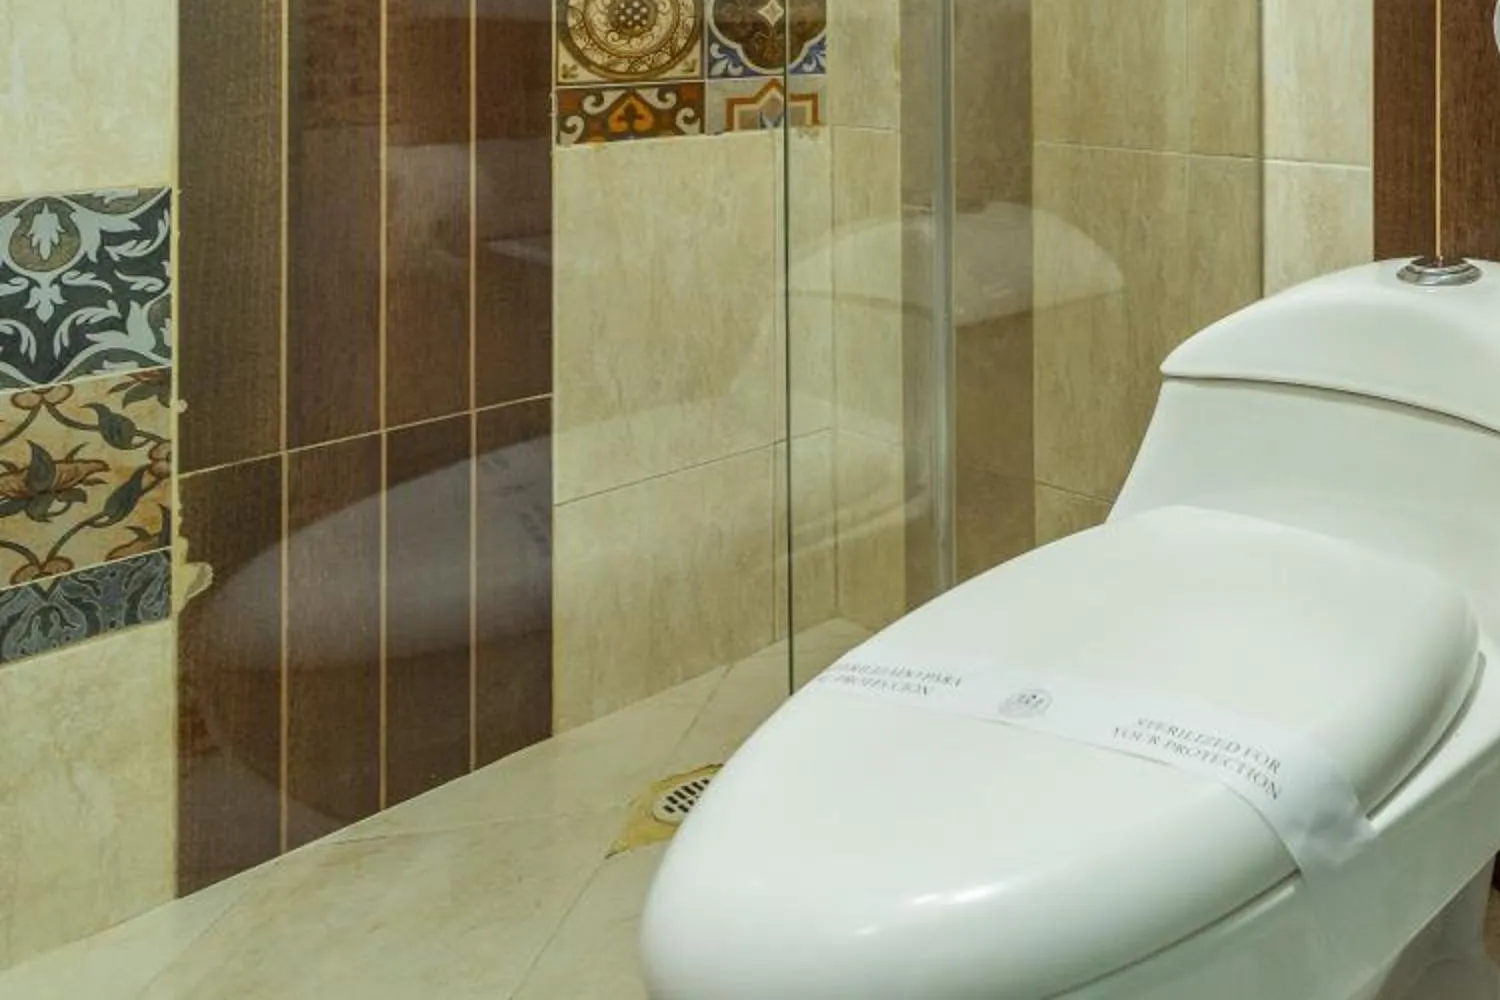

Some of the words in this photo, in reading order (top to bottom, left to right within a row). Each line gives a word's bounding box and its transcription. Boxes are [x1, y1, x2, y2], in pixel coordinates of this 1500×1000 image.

[1113, 726, 1160, 746] YOUR
[1163, 740, 1283, 800] PROTECTION
[1243, 747, 1281, 774] FOR
